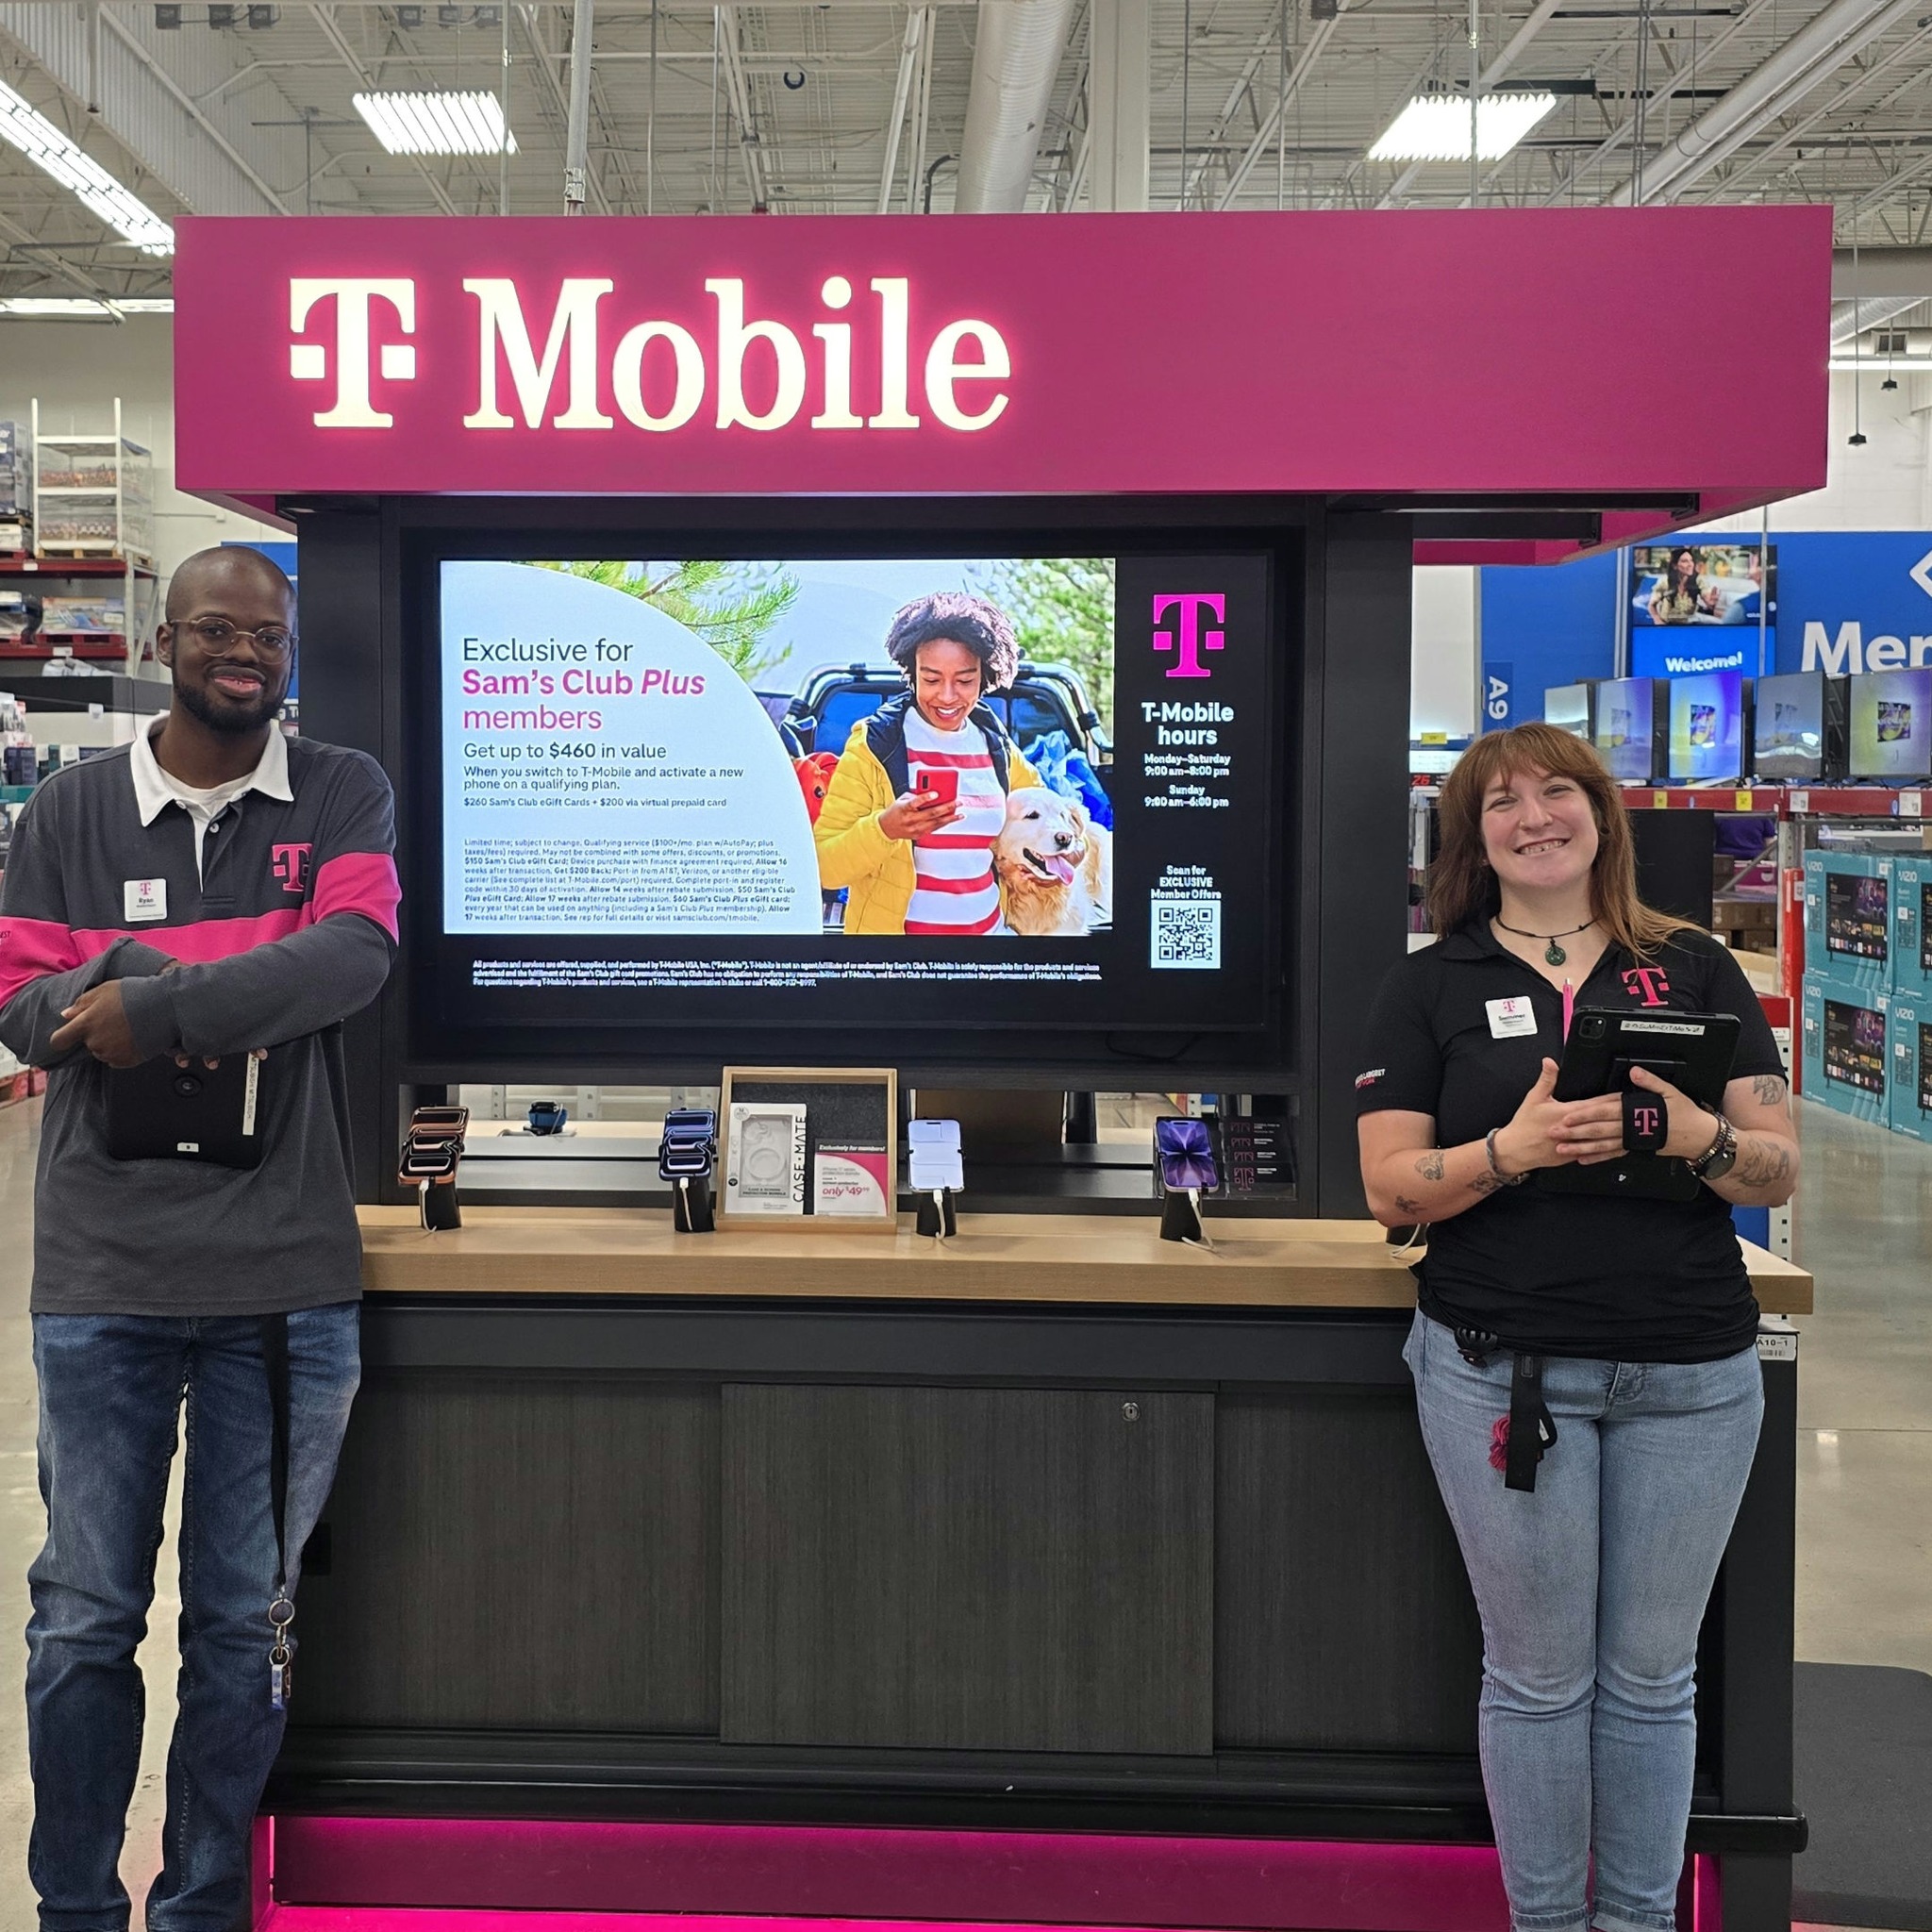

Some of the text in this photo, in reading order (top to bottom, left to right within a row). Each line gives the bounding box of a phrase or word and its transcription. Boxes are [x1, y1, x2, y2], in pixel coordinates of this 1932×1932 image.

[461, 275, 1012, 432] Mobile
[464, 638, 633, 661] Exclusive for
[1665, 651, 1742, 672] Welcome!
[462, 669, 705, 694] Sam's Club Plus
[1488, 675, 1508, 720] A9
[464, 704, 601, 729] members
[1141, 702, 1235, 723] T-Mobile
[1158, 725, 1218, 745] hours
[464, 741, 666, 760] Get up to $460 in value
[464, 766, 498, 776] When
[501, 769, 522, 778] you
[525, 767, 562, 776] switch
[566, 767, 578, 776] to
[581, 767, 631, 776] T-Mobile
[634, 767, 656, 776] and
[659, 767, 706, 776] activate
[1144, 766, 1168, 775] 9:00
[1213, 767, 1230, 778] pm
[464, 778, 500, 791] phone
[530, 778, 589, 791] qualifying
[591, 779, 620, 791] plan.
[1169, 785, 1206, 796] Sunday
[1144, 796, 1168, 807] 9:00
[1213, 798, 1230, 808] pm
[1166, 865, 1207, 875] Scan for
[1159, 876, 1213, 888] EXCLUSIVE
[1151, 889, 1191, 899] Member
[822, 1186, 844, 1197] only
